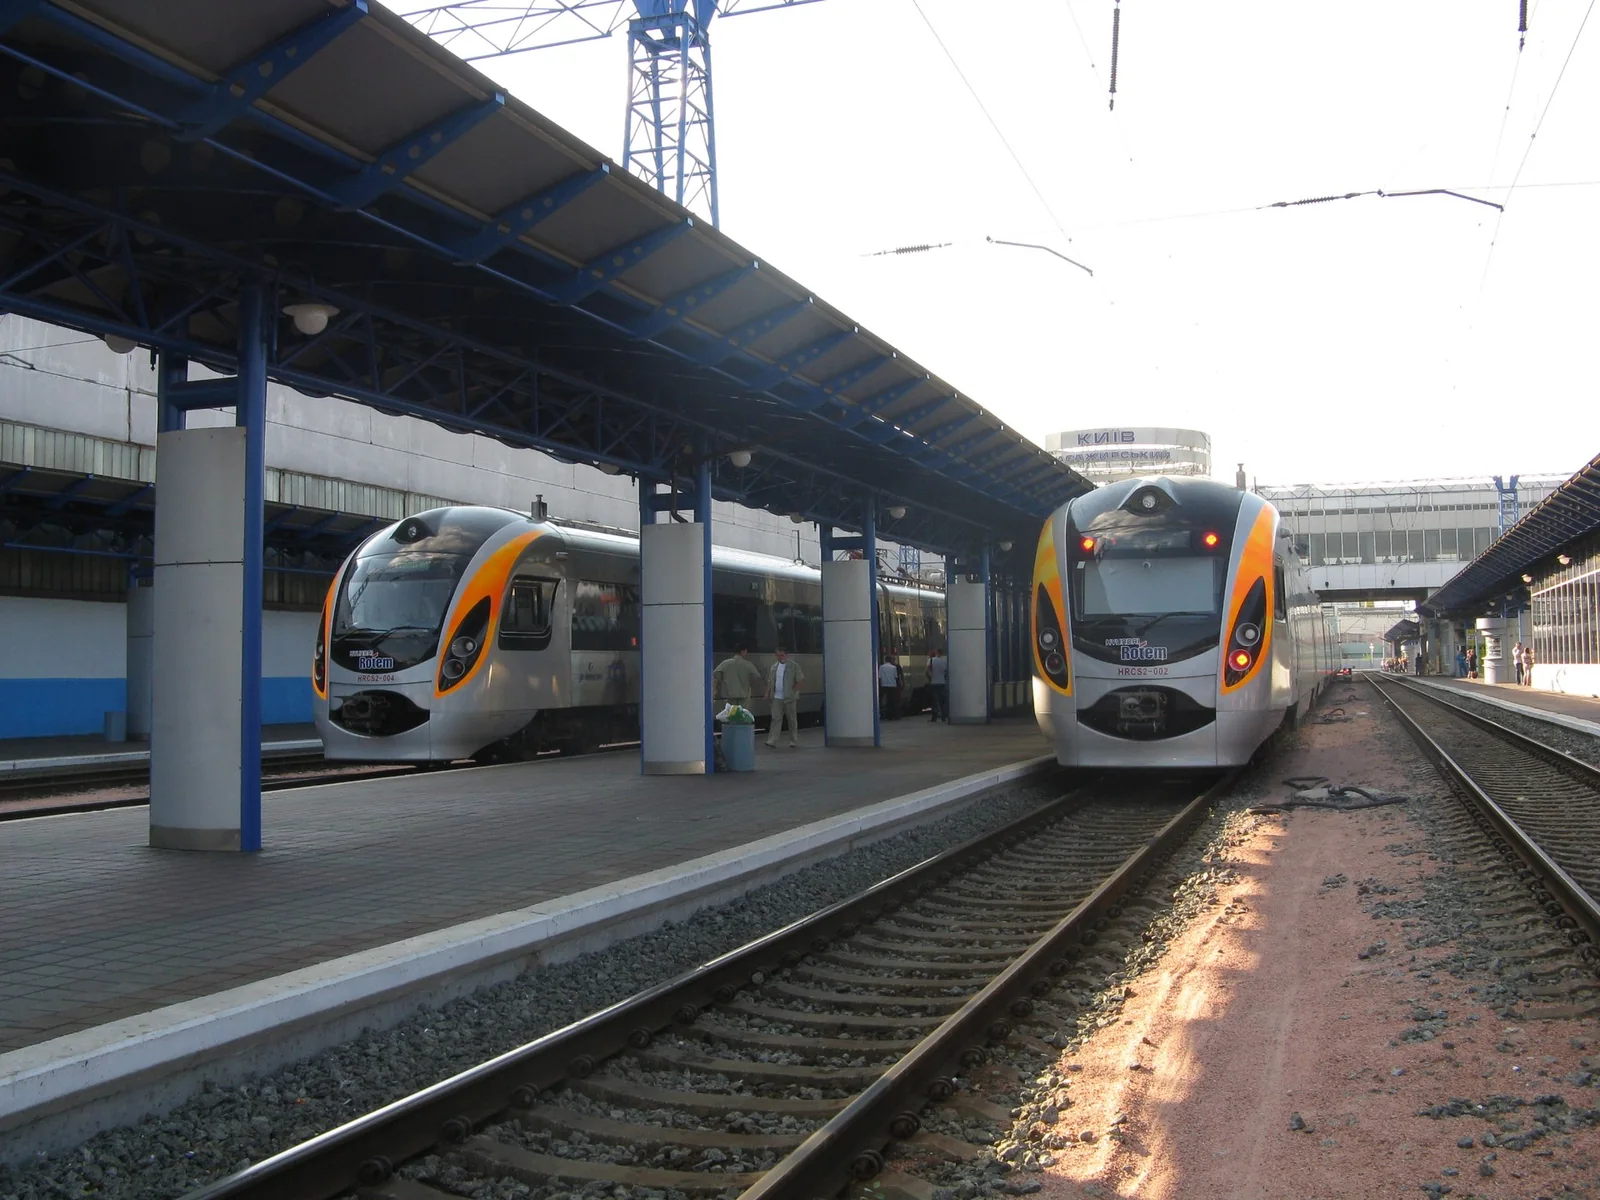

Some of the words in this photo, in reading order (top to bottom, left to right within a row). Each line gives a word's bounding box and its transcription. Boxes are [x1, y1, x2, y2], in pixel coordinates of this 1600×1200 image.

[1077, 429, 1135, 445] КИЇВ
[1057, 450, 1171, 463] АСАЖИРСЬКИЙ
[1121, 646, 1168, 660] Rotem
[359, 657, 393, 669] Rotem
[1117, 667, 1169, 676] HRCS2-002
[357, 674, 395, 682] HRCS2-004
